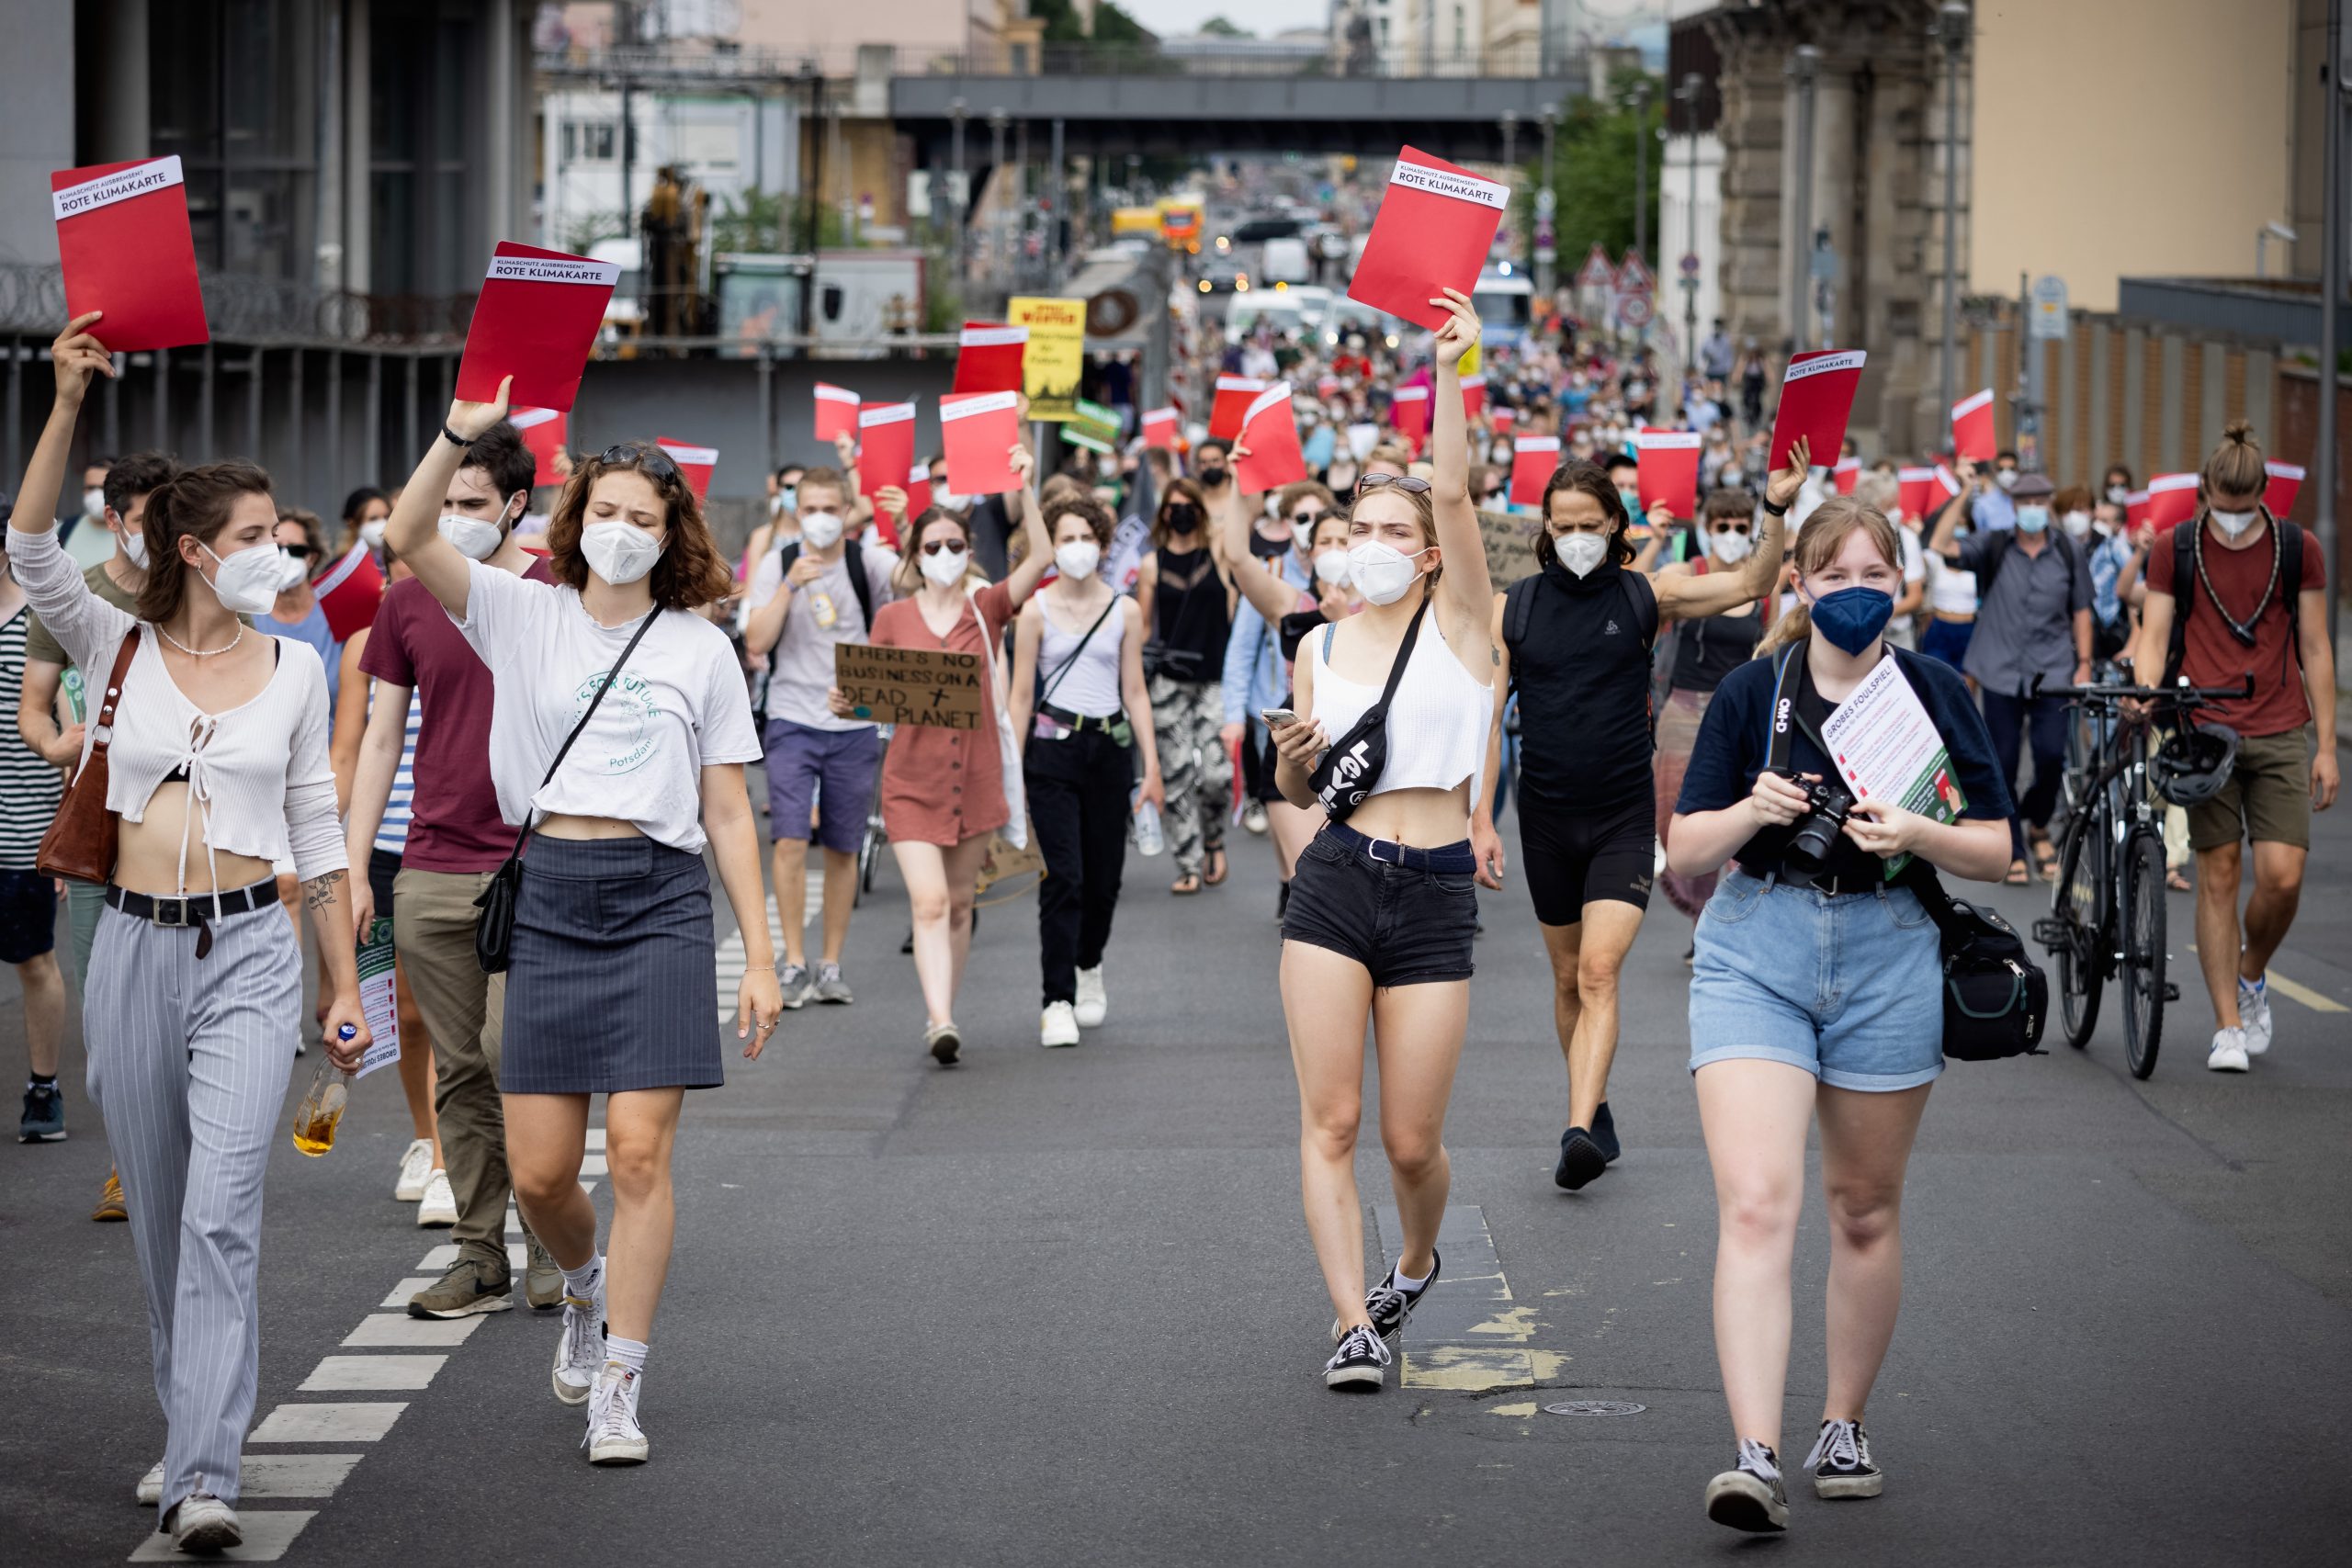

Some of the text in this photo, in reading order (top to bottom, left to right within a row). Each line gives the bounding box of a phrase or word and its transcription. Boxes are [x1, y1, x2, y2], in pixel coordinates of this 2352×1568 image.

[59, 170, 143, 200] KLIMASCHUTZ AUSBREMSEN?
[1399, 172, 1494, 201] ROTE KLIMAKARTE
[1400, 165, 1479, 186] KLIMASCHUTZ AUSBREMSEN?
[62, 172, 166, 212] ROTE KLIMAKARTE
[496, 266, 602, 280] ROTE KLIMAKARTE
[1790, 368, 1805, 378] ROTE
[1808, 359, 1853, 372] KLIMAKARTE
[943, 654, 976, 669] NO
[839, 664, 980, 687] BUSINESS ON A
[842, 685, 907, 706] DEAD
[1826, 705, 1854, 739] GROBES
[1853, 665, 1894, 708] FOULSPIEL!
[895, 706, 979, 729] PLANET
[1776, 698, 1791, 733] OM-D
[610, 738, 654, 768] Potsdam
[376, 1049, 397, 1064] GROBES
